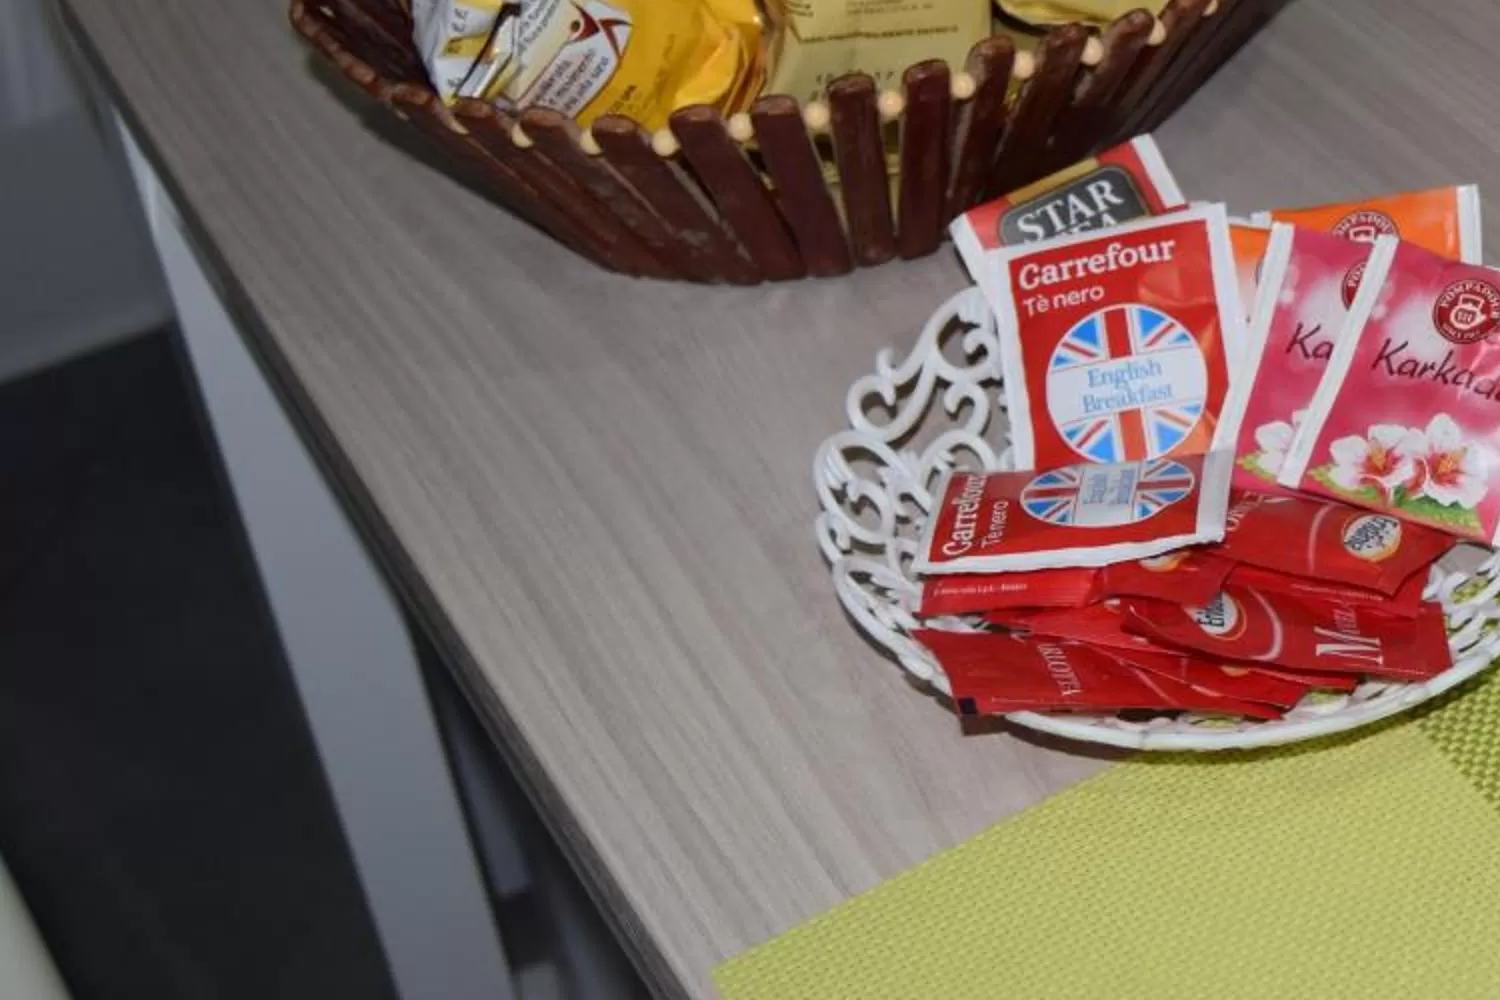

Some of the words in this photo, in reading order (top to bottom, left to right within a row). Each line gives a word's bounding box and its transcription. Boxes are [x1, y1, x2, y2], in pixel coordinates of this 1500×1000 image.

[1016, 179, 1125, 245] STAR
[1018, 239, 1177, 291] Carrefour
[1023, 296, 1050, 318] Tè
[1053, 284, 1106, 310] nero
[1086, 358, 1163, 391] English
[1082, 382, 1175, 415] Breakfast
